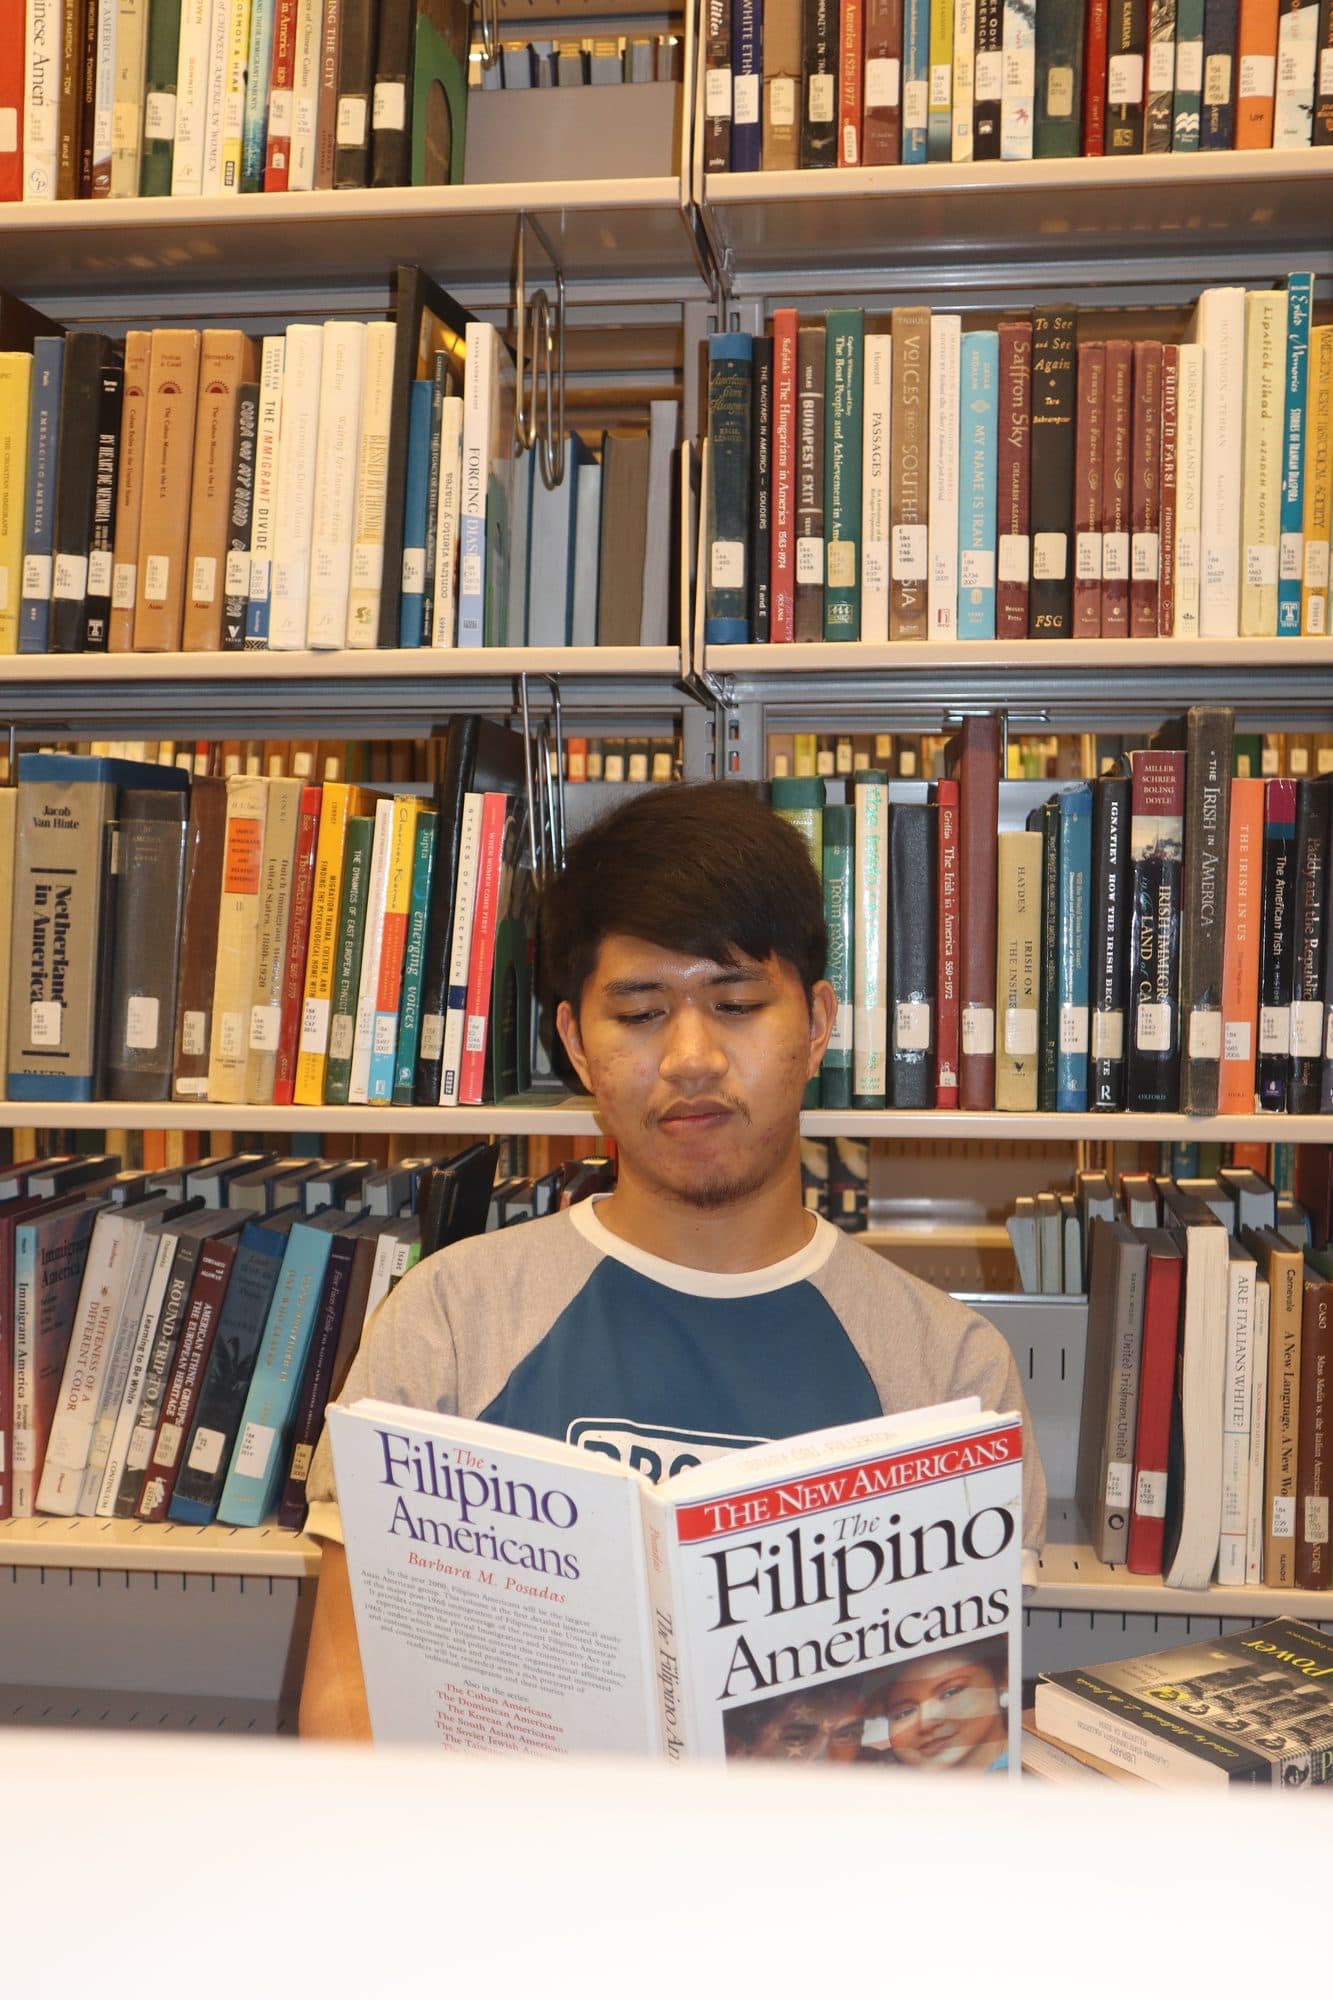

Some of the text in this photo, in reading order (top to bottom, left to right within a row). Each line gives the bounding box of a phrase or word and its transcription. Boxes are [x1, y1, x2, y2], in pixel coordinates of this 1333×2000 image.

[32, 0, 50, 107] inese Ameri
[280, 16, 290, 57] America
[327, 27, 336, 52] THE
[742, 0, 753, 75] WHITE ETHN
[846, 3, 856, 48] America
[325, 58, 334, 88] CITY
[1052, 337, 1072, 350] See
[1055, 317, 1073, 330] See
[779, 380, 791, 400] The
[1007, 340, 1029, 448] Saffron Sky
[1033, 358, 1071, 372] Again
[1257, 305, 1274, 419] Lipstick Jihad
[759, 365, 768, 529] THE MAGYARS IN AMERICA SOUDERS
[776, 404, 790, 467] Hungarians
[801, 400, 815, 504] BUDAPEST EXIT
[831, 336, 845, 519] The Boat People and Achievement in
[871, 412, 882, 477] PASSAGES
[34, 410, 48, 534] EMBRACING AMERICA
[95, 434, 115, 522] BY HEART DE MEMORIA
[257, 401, 276, 551] THE IMMIGRANT DIVIDE
[443, 472, 453, 507] marea
[467, 447, 480, 513] FORGING
[777, 482, 789, 525] America
[779, 471, 789, 481] in
[901, 335, 920, 607] VOICES SOUTHE SIA
[971, 425, 985, 548] MY NAME IS IRAN
[440, 521, 451, 555] viento
[441, 557, 450, 598] contra
[1034, 615, 1064, 628] FSG
[42, 805, 71, 818] Jacob
[1200, 760, 1221, 928] THE IRISH IN AMERICA
[944, 846, 955, 869] The
[944, 872, 955, 896] Irish
[1016, 866, 1027, 913] HAYDEN
[1105, 801, 1119, 973] IGNATIEV HOW THE IRISH
[1237, 824, 1249, 942] THE IRISH IN US
[343, 867, 360, 977] DYNAMICS OF EAST EUROPEAN
[455, 808, 475, 979] STATES OF EXCEPTION
[944, 898, 955, 908] in
[1272, 856, 1287, 956] The American Irish
[30, 884, 52, 1004] in America
[50, 884, 72, 1009] Netherland
[944, 912, 955, 955] America
[1139, 915, 1154, 960] LAND
[404, 911, 426, 1029] emerging voices
[943, 961, 954, 1000] 550-1972
[1023, 940, 1033, 996] IRISH ON
[1139, 1093, 1166, 1101] OXFORD
[15, 1283, 29, 1399] Immigrant America
[87, 1305, 111, 1373] WHITENESS
[143, 1279, 186, 1401] ROUND-TRIP TO
[193, 1303, 213, 1351] AMERICAN
[1318, 1303, 1328, 1329] CASO
[66, 1301, 99, 1411] DIFFERENT COLOR
[126, 1314, 154, 1406] Learning to Be White
[166, 1301, 202, 1416] THE EUROPEAN HERITAGE
[184, 1352, 201, 1385] ETHNIC
[1121, 1333, 1134, 1368] United
[1232, 1275, 1250, 1427] ARE ITALIANS WHITE?
[1280, 1269, 1296, 1433] Carnevale New Language,
[453, 1447, 485, 1469] The
[1115, 1422, 1130, 1459] United
[101, 1460, 118, 1509] CONTINUUM
[373, 1429, 578, 1529] Filipino
[704, 1438, 1010, 1532] THE NEW AMERICANS
[388, 1495, 581, 1580] Americans
[832, 1512, 881, 1541] The
[408, 1552, 567, 1603] Barbara M. Posadas
[700, 1505, 1015, 1632] Filipino
[1279, 1554, 1287, 1582] ILLINOIS
[716, 1588, 1010, 1701] Americans
[657, 1650, 680, 1726] Filipino
